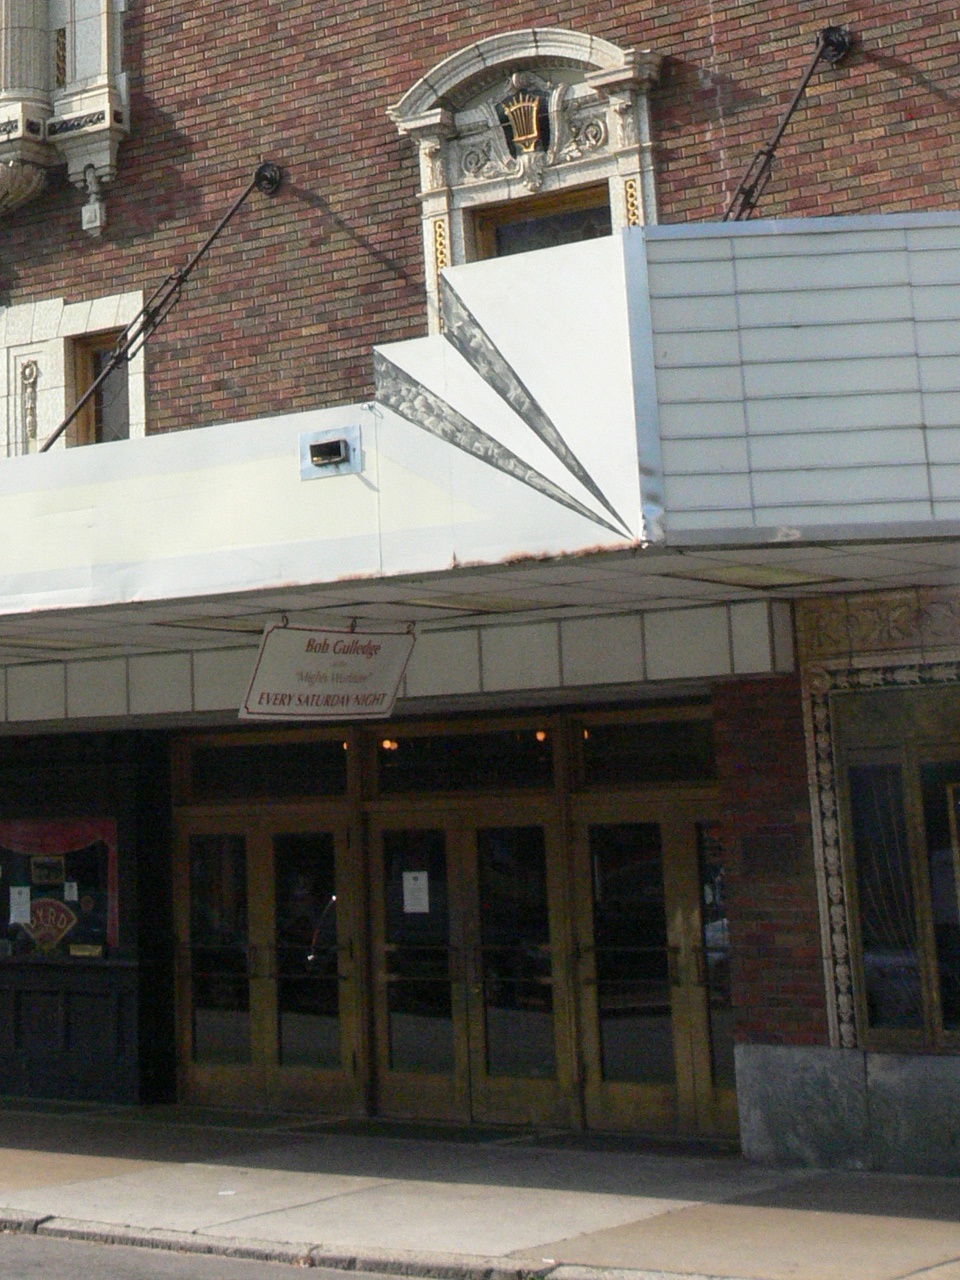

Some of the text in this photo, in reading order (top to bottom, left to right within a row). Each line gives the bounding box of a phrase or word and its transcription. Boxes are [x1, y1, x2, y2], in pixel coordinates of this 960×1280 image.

[305, 638, 381, 659] Bob Gulledge
[258, 691, 388, 707] EVERY SATURDAY NIGHT
